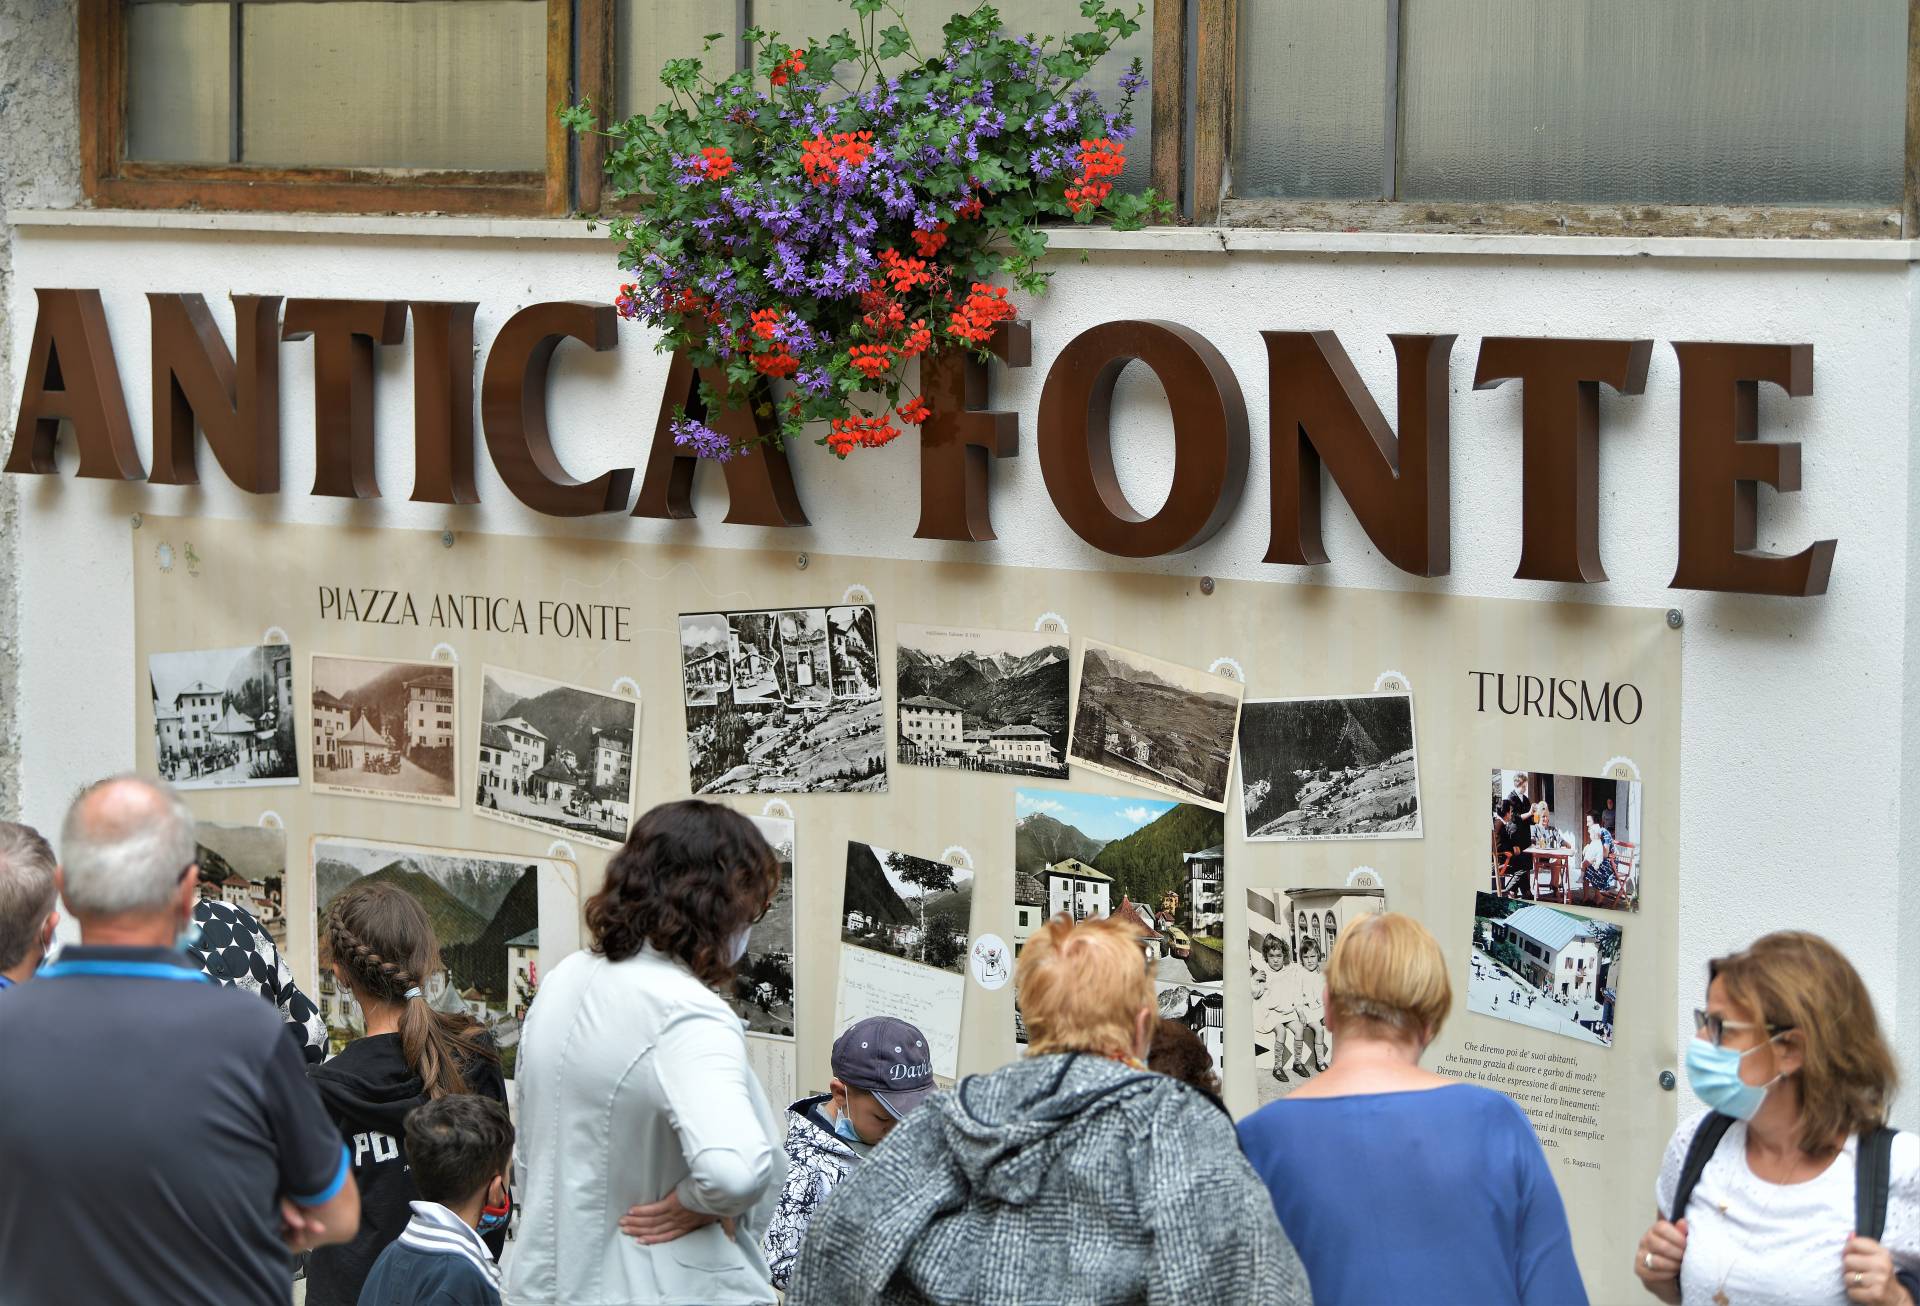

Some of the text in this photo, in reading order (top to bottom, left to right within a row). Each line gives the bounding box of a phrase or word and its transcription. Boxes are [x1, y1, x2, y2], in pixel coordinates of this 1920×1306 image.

[4, 288, 1838, 597] ANTICA FONTE
[319, 586, 632, 642] PIAZZA ANTICA FONTE
[1044, 623, 1058, 633] 1907
[1384, 681, 1400, 691] 1940
[1468, 671, 1643, 725] TURISMO
[1464, 1041, 1478, 1052] Che
[1480, 1043, 1505, 1055] diremo
[1506, 1048, 1518, 1058] poi
[1531, 1051, 1546, 1061] suoi
[1547, 1053, 1578, 1066] abitanti,
[1445, 1053, 1458, 1062] che
[1460, 1054, 1482, 1066] hanno
[1482, 1060, 1506, 1068] grazia
[1507, 1061, 1515, 1070] di
[1516, 1064, 1536, 1074] cuore
[1542, 1067, 1565, 1077] garbo
[1565, 1069, 1573, 1079] di
[1574, 1073, 1597, 1083] modi?
[1436, 1065, 1606, 1098] Diremo che la dolce espressione di anime serene
[1530, 1094, 1542, 1103] nei
[1543, 1094, 1558, 1105] loro
[1559, 1097, 1600, 1111] lineamenti:
[1544, 1109, 1553, 1119] ed
[1554, 1111, 1598, 1126] inalterabile,
[1549, 1123, 1557, 1133] di
[1558, 1126, 1572, 1136] vita
[1573, 1128, 1605, 1141] semplice
